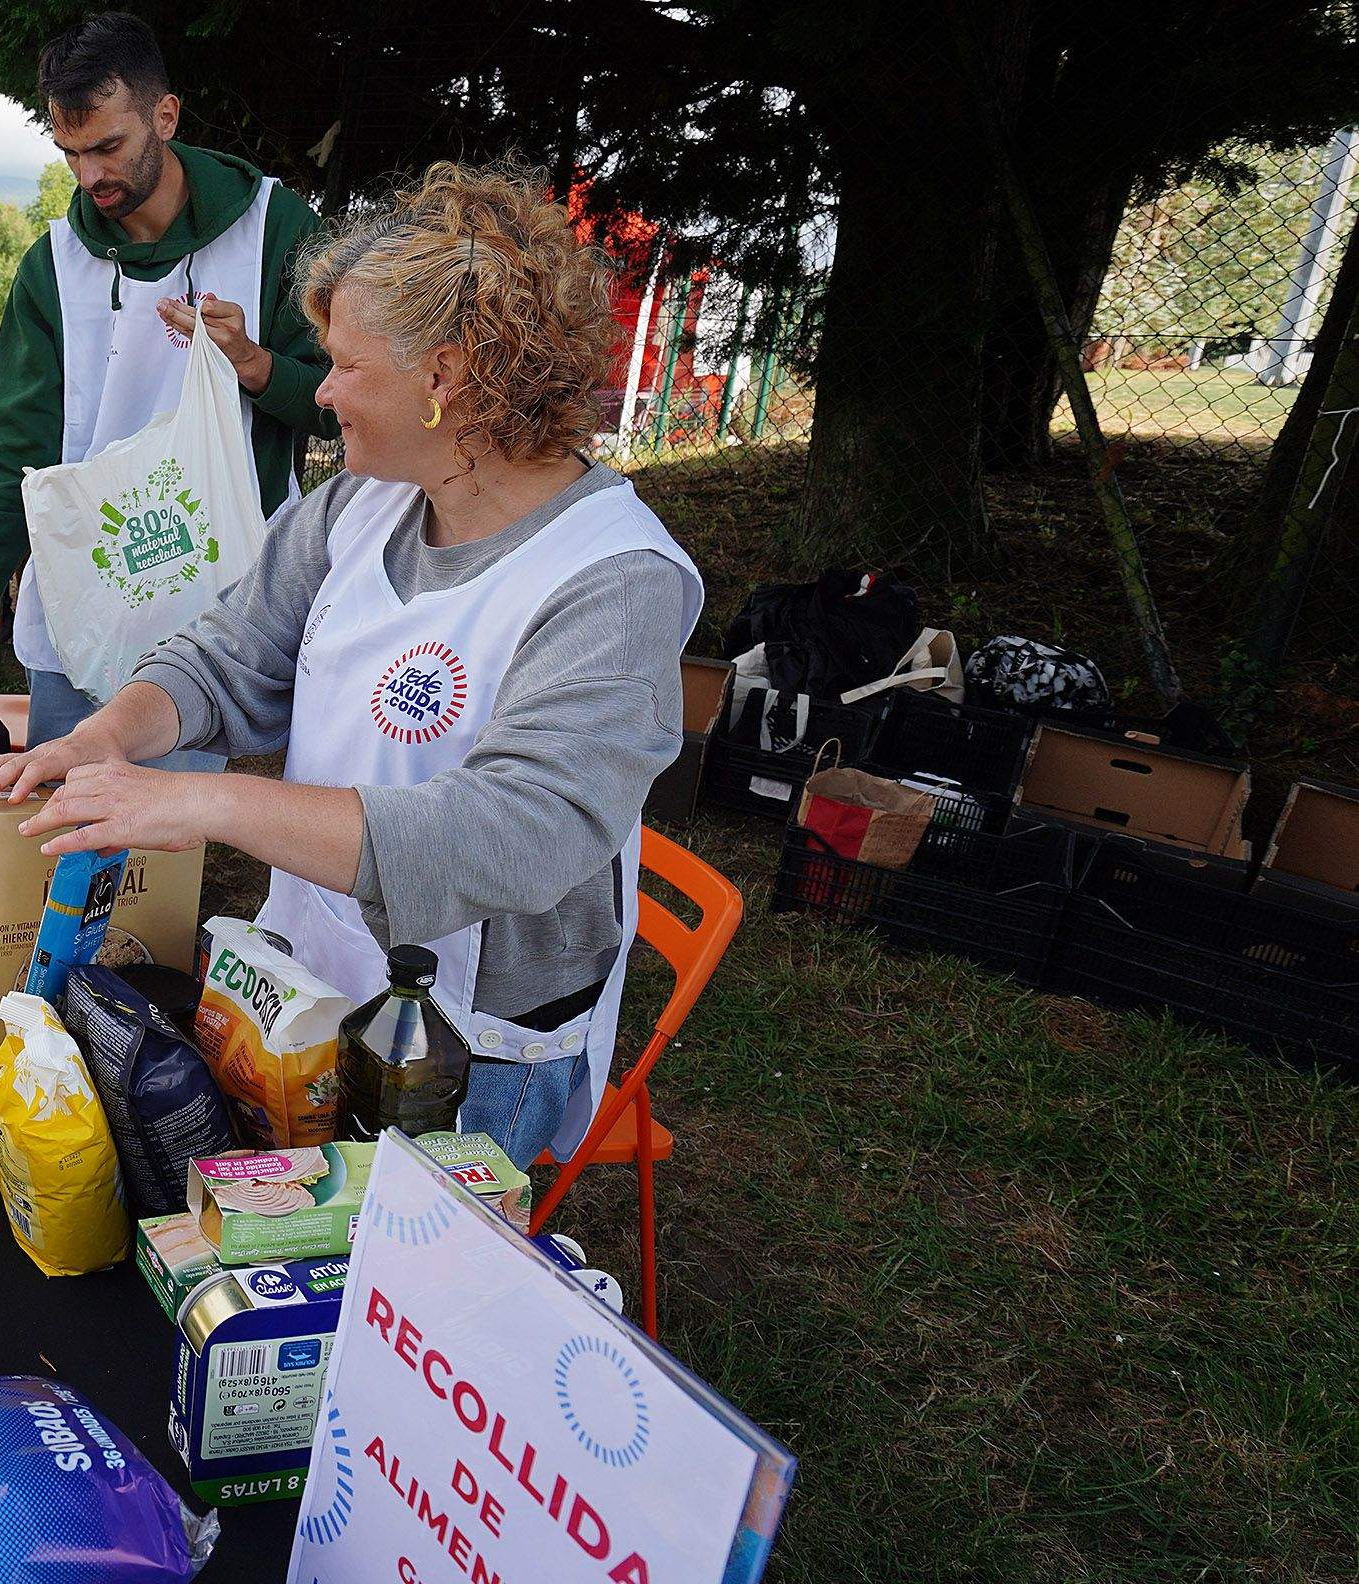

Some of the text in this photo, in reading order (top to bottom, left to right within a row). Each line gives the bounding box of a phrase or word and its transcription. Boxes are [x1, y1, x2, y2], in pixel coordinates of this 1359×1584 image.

[126, 506, 181, 542] 80%
[131, 527, 181, 558] material
[136, 544, 183, 570] reciclado
[400, 666, 443, 694] rede
[386, 678, 441, 716] AXUDA
[384, 696, 425, 722] .com
[126, 856, 147, 868] RIGO
[84, 902, 112, 924] GALLO
[2, 932, 34, 944] HIERRO
[11, 922, 16, 932] 7
[243, 1157, 278, 1166] Reduced
[245, 1162, 282, 1170] Reduzido
[248, 1166, 284, 1176] Reducido
[309, 1262, 351, 1280] ATÚN
[314, 1282, 330, 1291] EN
[260, 1376, 278, 1386] 416
[272, 1386, 290, 1397] 560
[21, 1400, 92, 1472] SOBAOS
[72, 1408, 125, 1469] 36 UNIDADES
[366, 1286, 650, 1584] RECOLLIDA
[221, 1476, 300, 1499] 8 LATAS
[451, 1458, 506, 1540] DE
